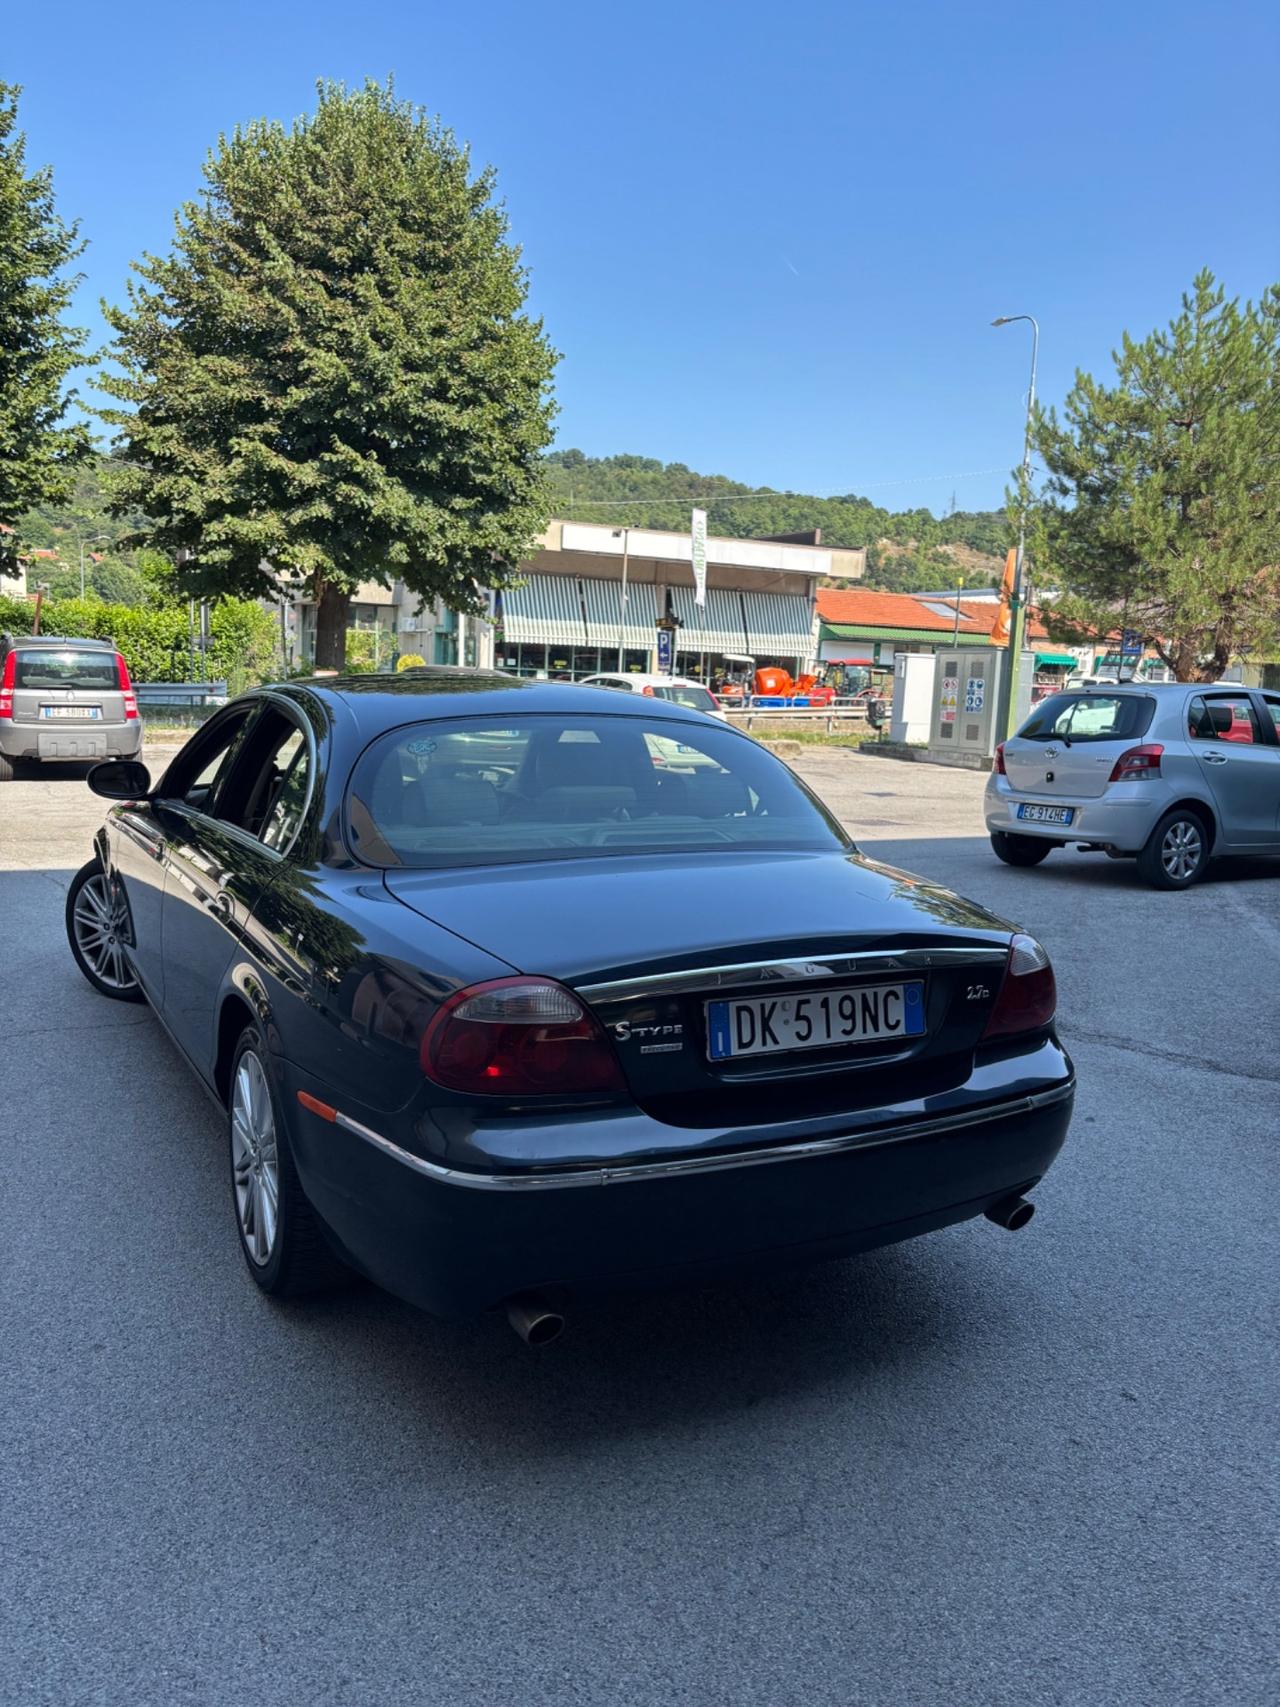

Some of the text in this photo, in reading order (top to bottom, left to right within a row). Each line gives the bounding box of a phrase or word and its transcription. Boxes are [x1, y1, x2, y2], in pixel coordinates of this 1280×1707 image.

[660, 634, 668, 648] P
[736, 1001, 780, 1050] DK
[795, 989, 901, 1042] 519NC
